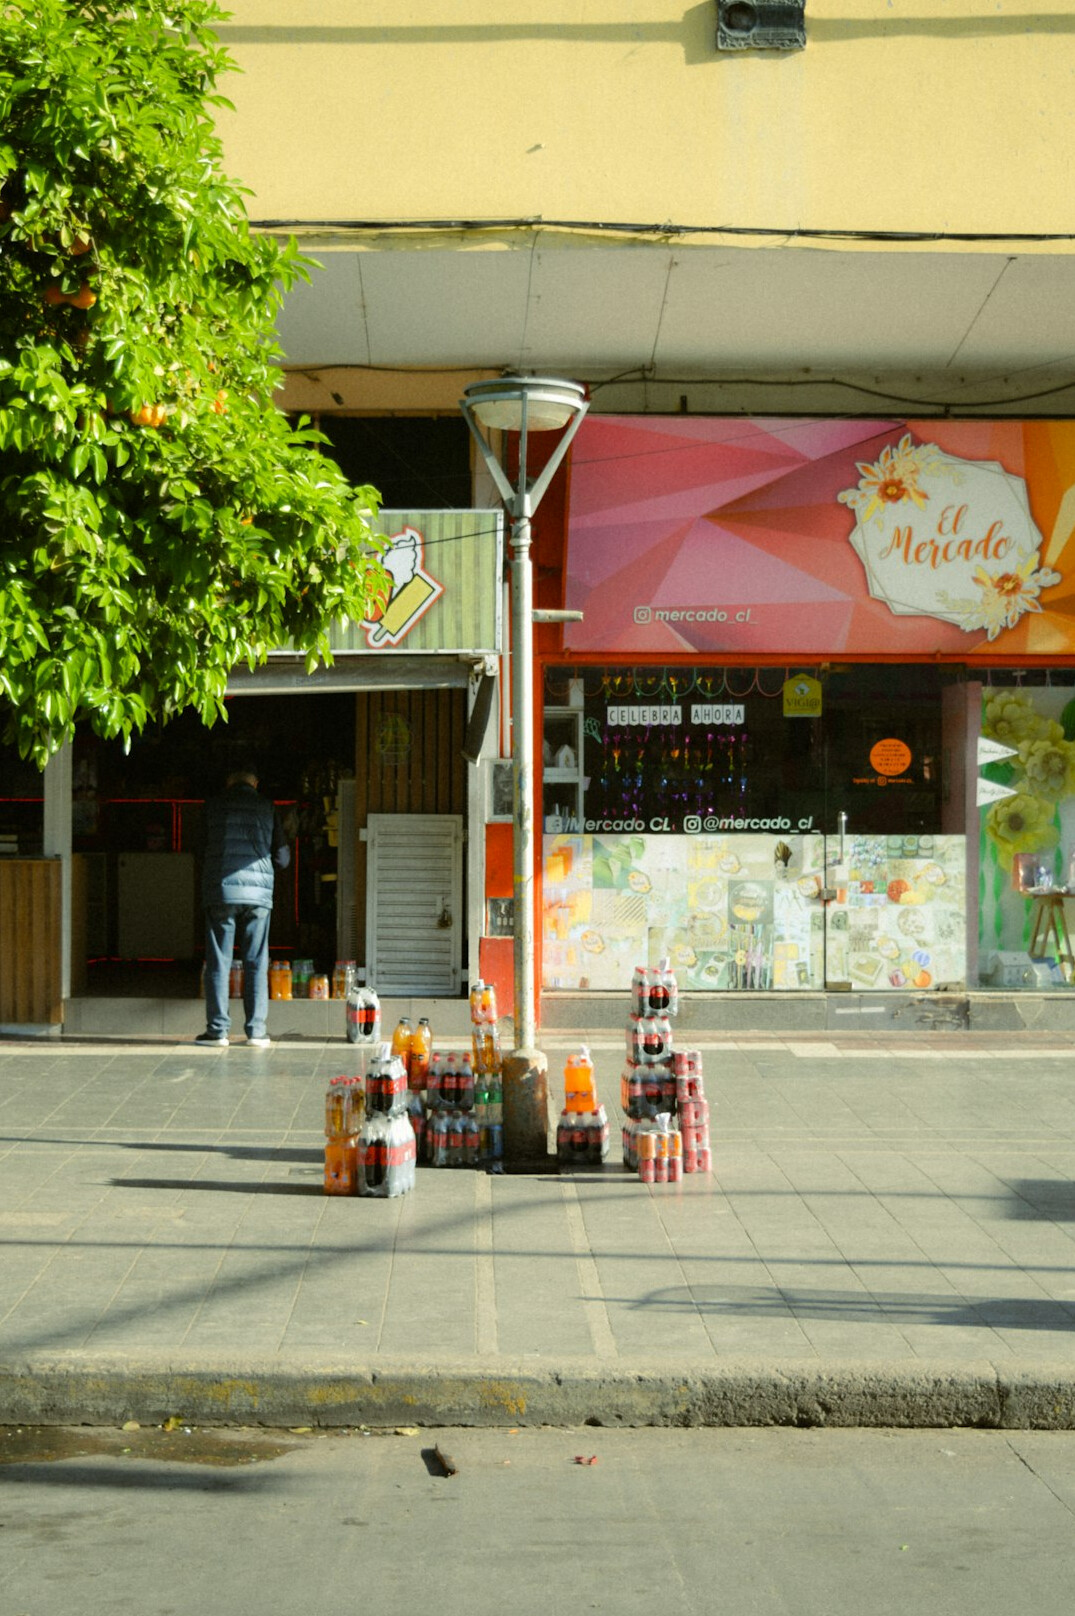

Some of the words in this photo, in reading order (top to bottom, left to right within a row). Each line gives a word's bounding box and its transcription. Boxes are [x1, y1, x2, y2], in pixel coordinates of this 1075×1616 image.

[937, 503, 969, 536] El
[878, 519, 1017, 571] Mercado
[655, 608, 759, 625] mercado_cl_
[609, 709, 680, 722] CELEBRA
[693, 708, 742, 721] AHORA
[649, 817, 671, 832] CL
[703, 815, 821, 833] @mercado_cl_
